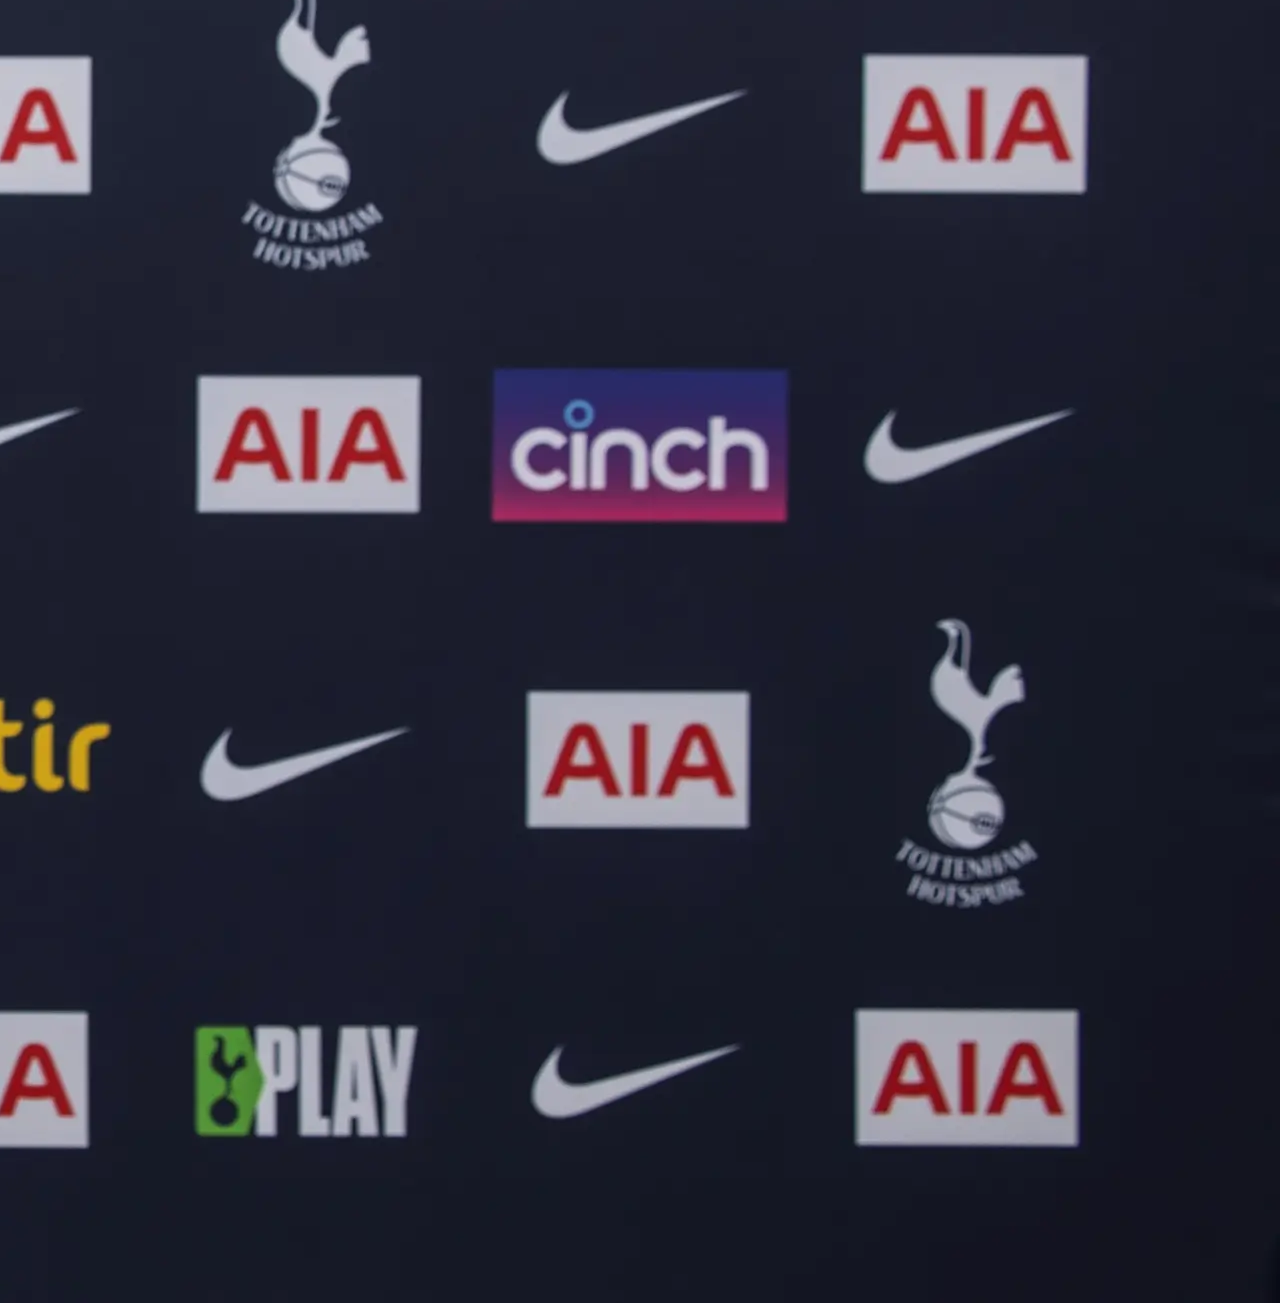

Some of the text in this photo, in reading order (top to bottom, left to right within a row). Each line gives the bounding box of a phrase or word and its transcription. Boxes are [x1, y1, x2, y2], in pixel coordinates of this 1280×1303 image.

[881, 86, 1071, 162] AIA
[241, 200, 383, 243] TOTTENHAM
[252, 237, 370, 271] HOTSPUR
[215, 407, 405, 482] AIA
[509, 398, 770, 493] cinch
[544, 723, 734, 798] AIA
[254, 1025, 418, 1138] PLAY
[874, 1041, 1063, 1117] AIA
